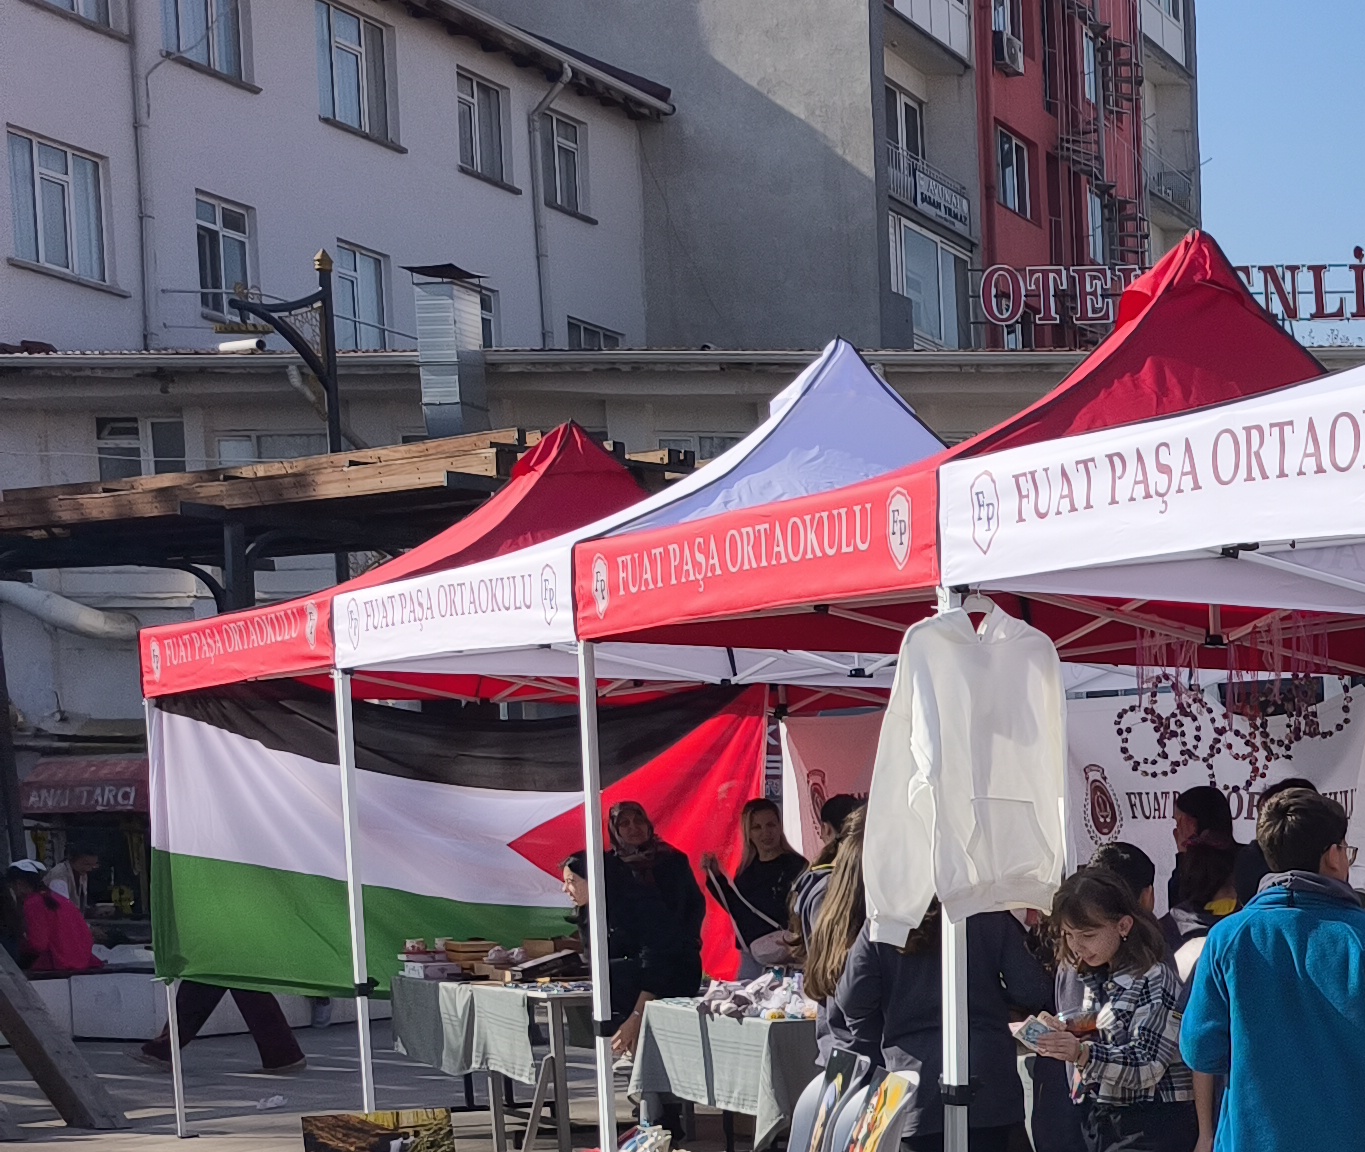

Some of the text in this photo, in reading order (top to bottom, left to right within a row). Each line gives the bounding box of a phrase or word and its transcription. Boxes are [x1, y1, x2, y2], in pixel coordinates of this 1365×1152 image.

[980, 263, 1141, 325] OTE
[1011, 457, 1097, 525] FUAT
[1104, 435, 1203, 515] PAŞA
[892, 508, 908, 549] FP
[974, 488, 997, 532] FP
[616, 502, 873, 597] FUAT PAŞA ORTAOKULU
[363, 573, 533, 632] FUAT PAŞA ORTAOKULU
[164, 607, 300, 667] FUAT PAŞA ORTAOKULU
[1125, 790, 1170, 820] FUAT
